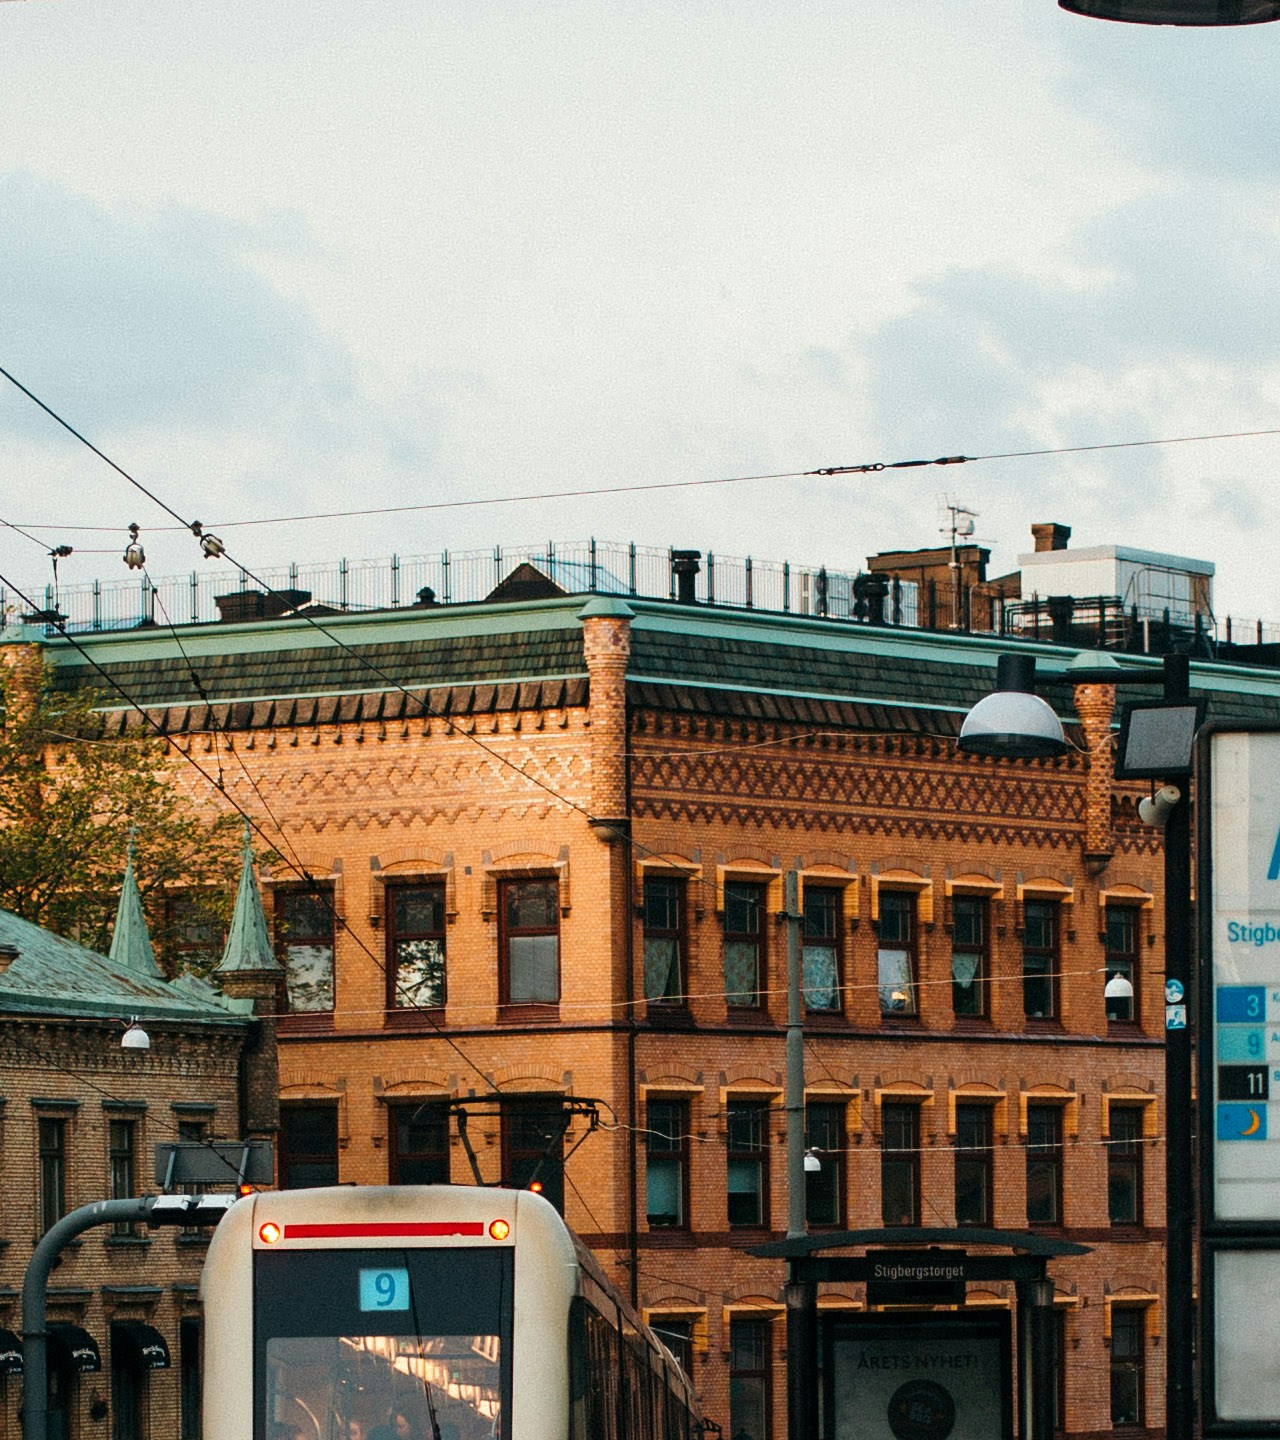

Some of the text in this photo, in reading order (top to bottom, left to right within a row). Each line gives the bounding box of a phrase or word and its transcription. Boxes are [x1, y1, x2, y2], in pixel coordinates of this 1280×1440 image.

[1247, 994, 1259, 1017] 3
[1247, 1032, 1260, 1056] 9
[1247, 1072, 1263, 1095] 11
[874, 1264, 964, 1280] Stigbergstorget
[374, 1272, 396, 1308] 9
[857, 1351, 979, 1370] ÅRETS NYHET!
